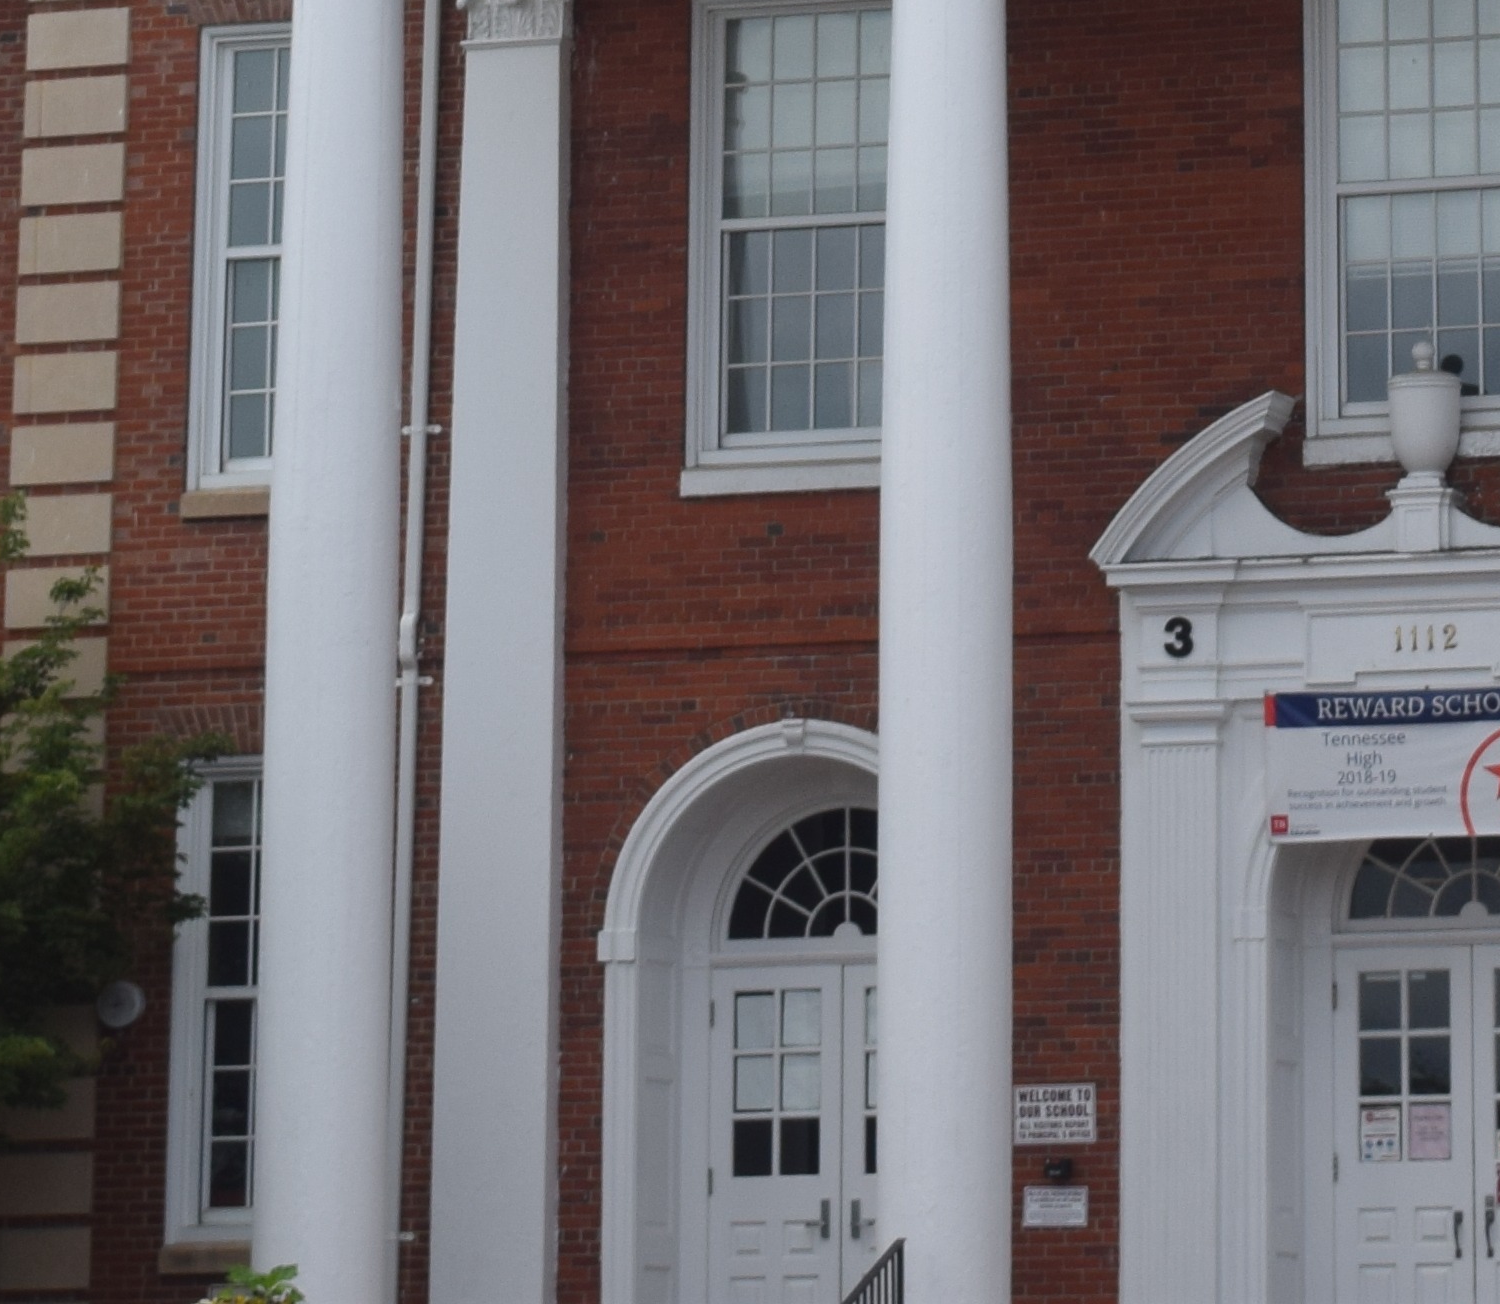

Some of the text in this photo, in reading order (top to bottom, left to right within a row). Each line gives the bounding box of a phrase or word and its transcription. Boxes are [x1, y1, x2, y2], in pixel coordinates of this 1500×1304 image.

[1164, 616, 1194, 658] 3
[1394, 623, 1459, 652] 1112
[1317, 694, 1425, 720] REWARD
[1321, 731, 1406, 747] Tennessee
[1346, 750, 1383, 769] High
[1337, 769, 1397, 785] 2018-19
[1413, 785, 1447, 794] student
[1019, 1088, 1091, 1102] WELCOME TO
[1019, 1103, 1089, 1117] OUR SCHOOL
